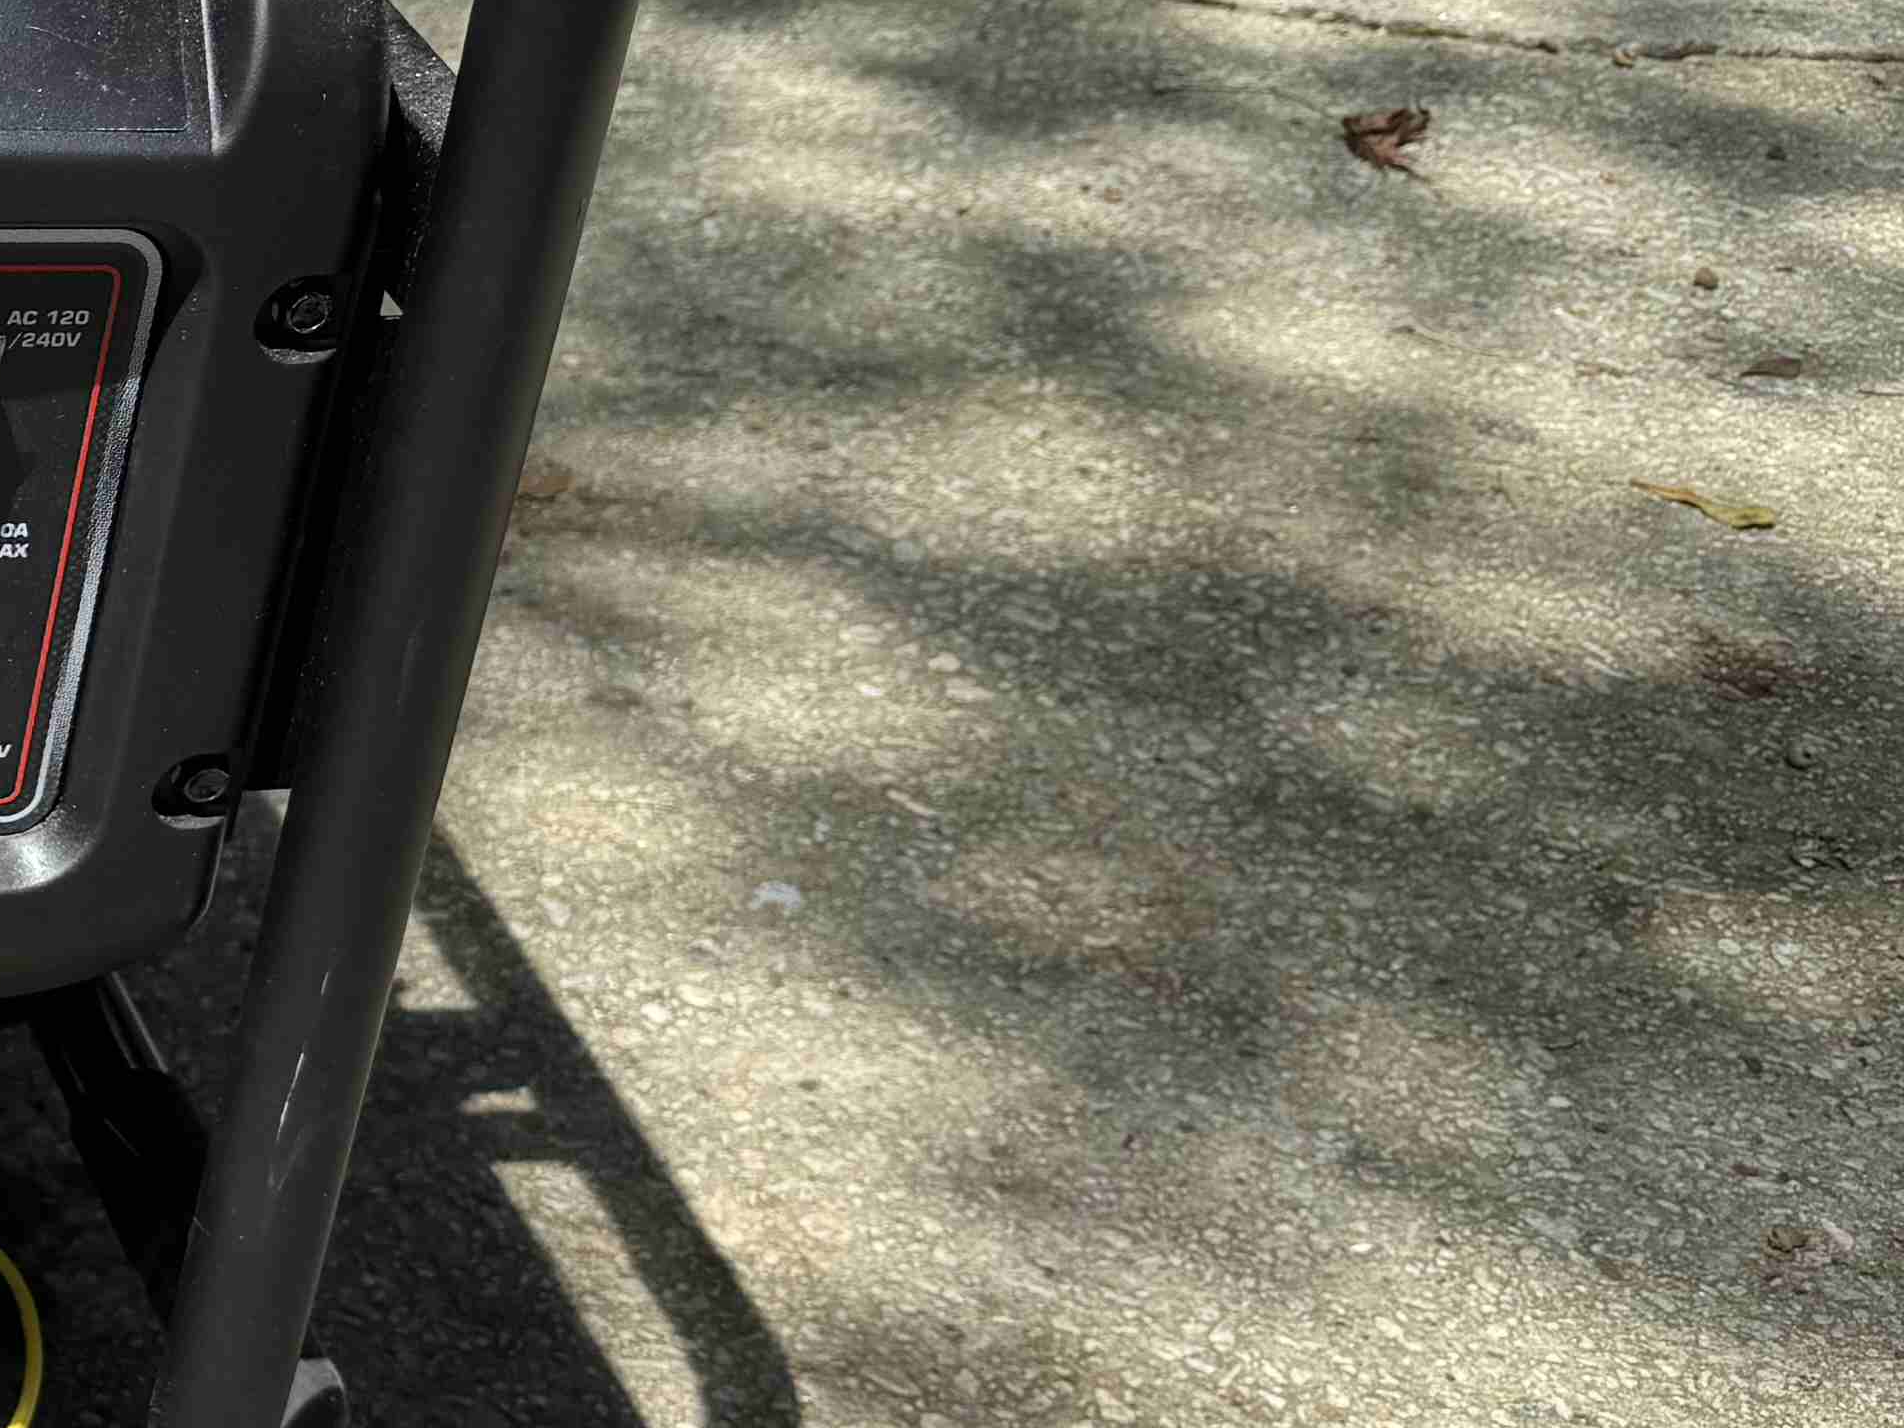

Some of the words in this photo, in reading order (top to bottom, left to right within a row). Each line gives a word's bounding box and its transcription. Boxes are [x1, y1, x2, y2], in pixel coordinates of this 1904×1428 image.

[7, 309, 41, 326] AC
[47, 309, 90, 326] 120
[8, 331, 81, 350] /240V
